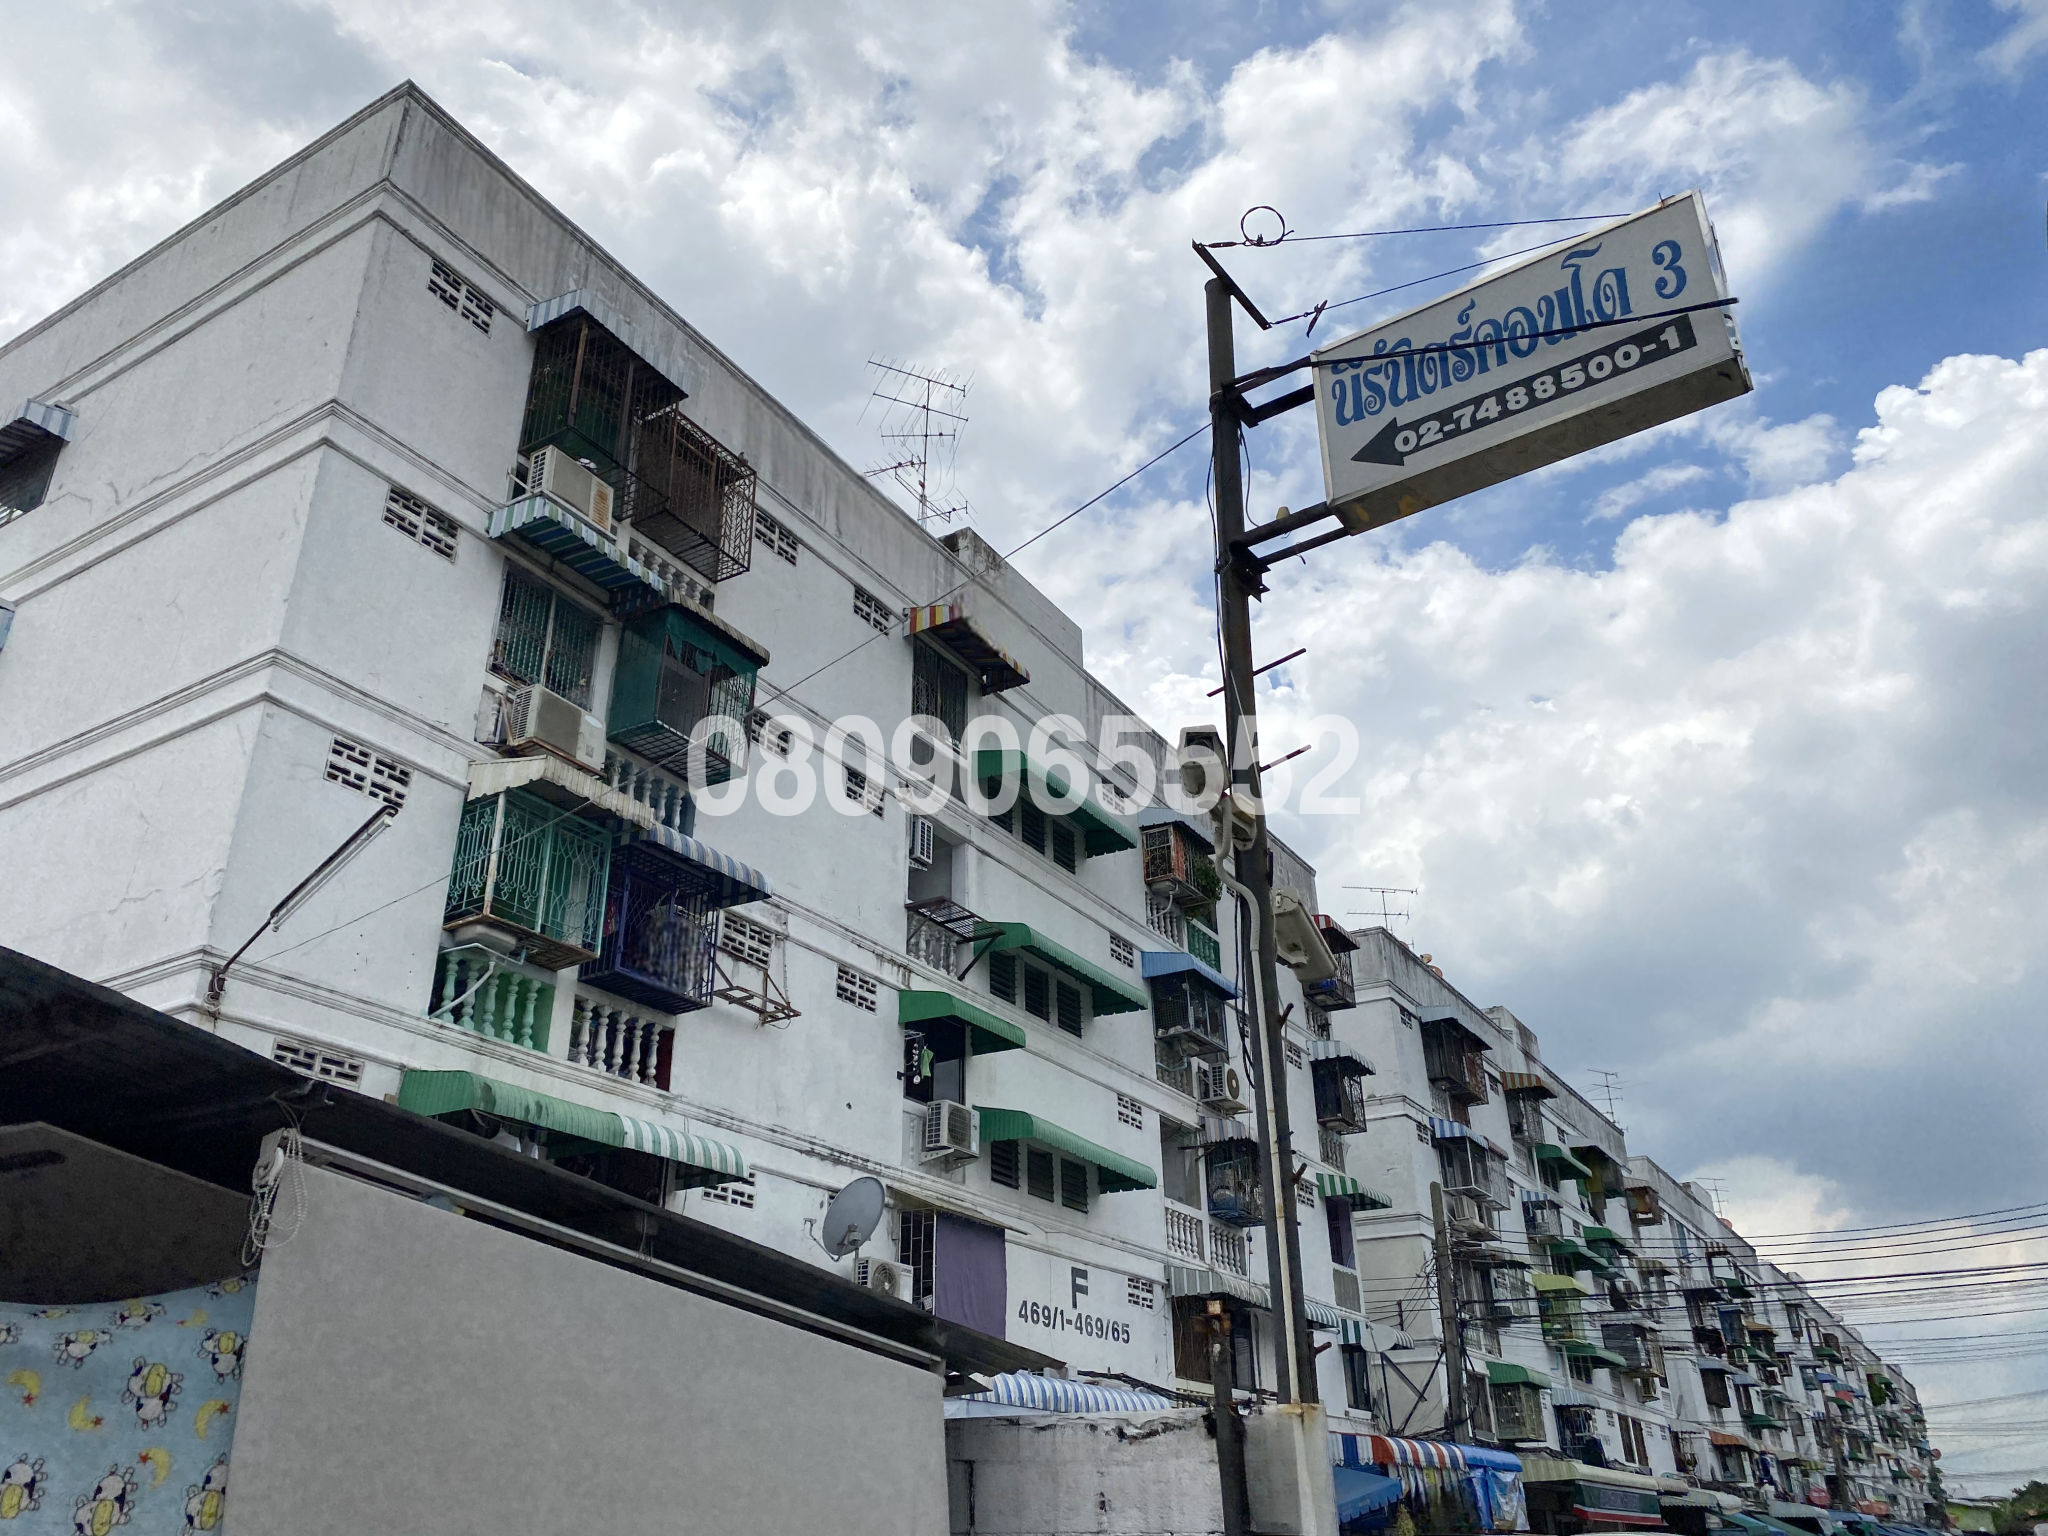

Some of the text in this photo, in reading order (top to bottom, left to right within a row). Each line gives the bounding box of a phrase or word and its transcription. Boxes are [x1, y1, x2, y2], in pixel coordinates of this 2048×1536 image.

[1652, 239, 1687, 299] 3
[1394, 325, 1682, 453] 02-7488500-1
[1071, 1266, 1089, 1310] F
[1018, 1300, 1131, 1344] 469/1-469/65
